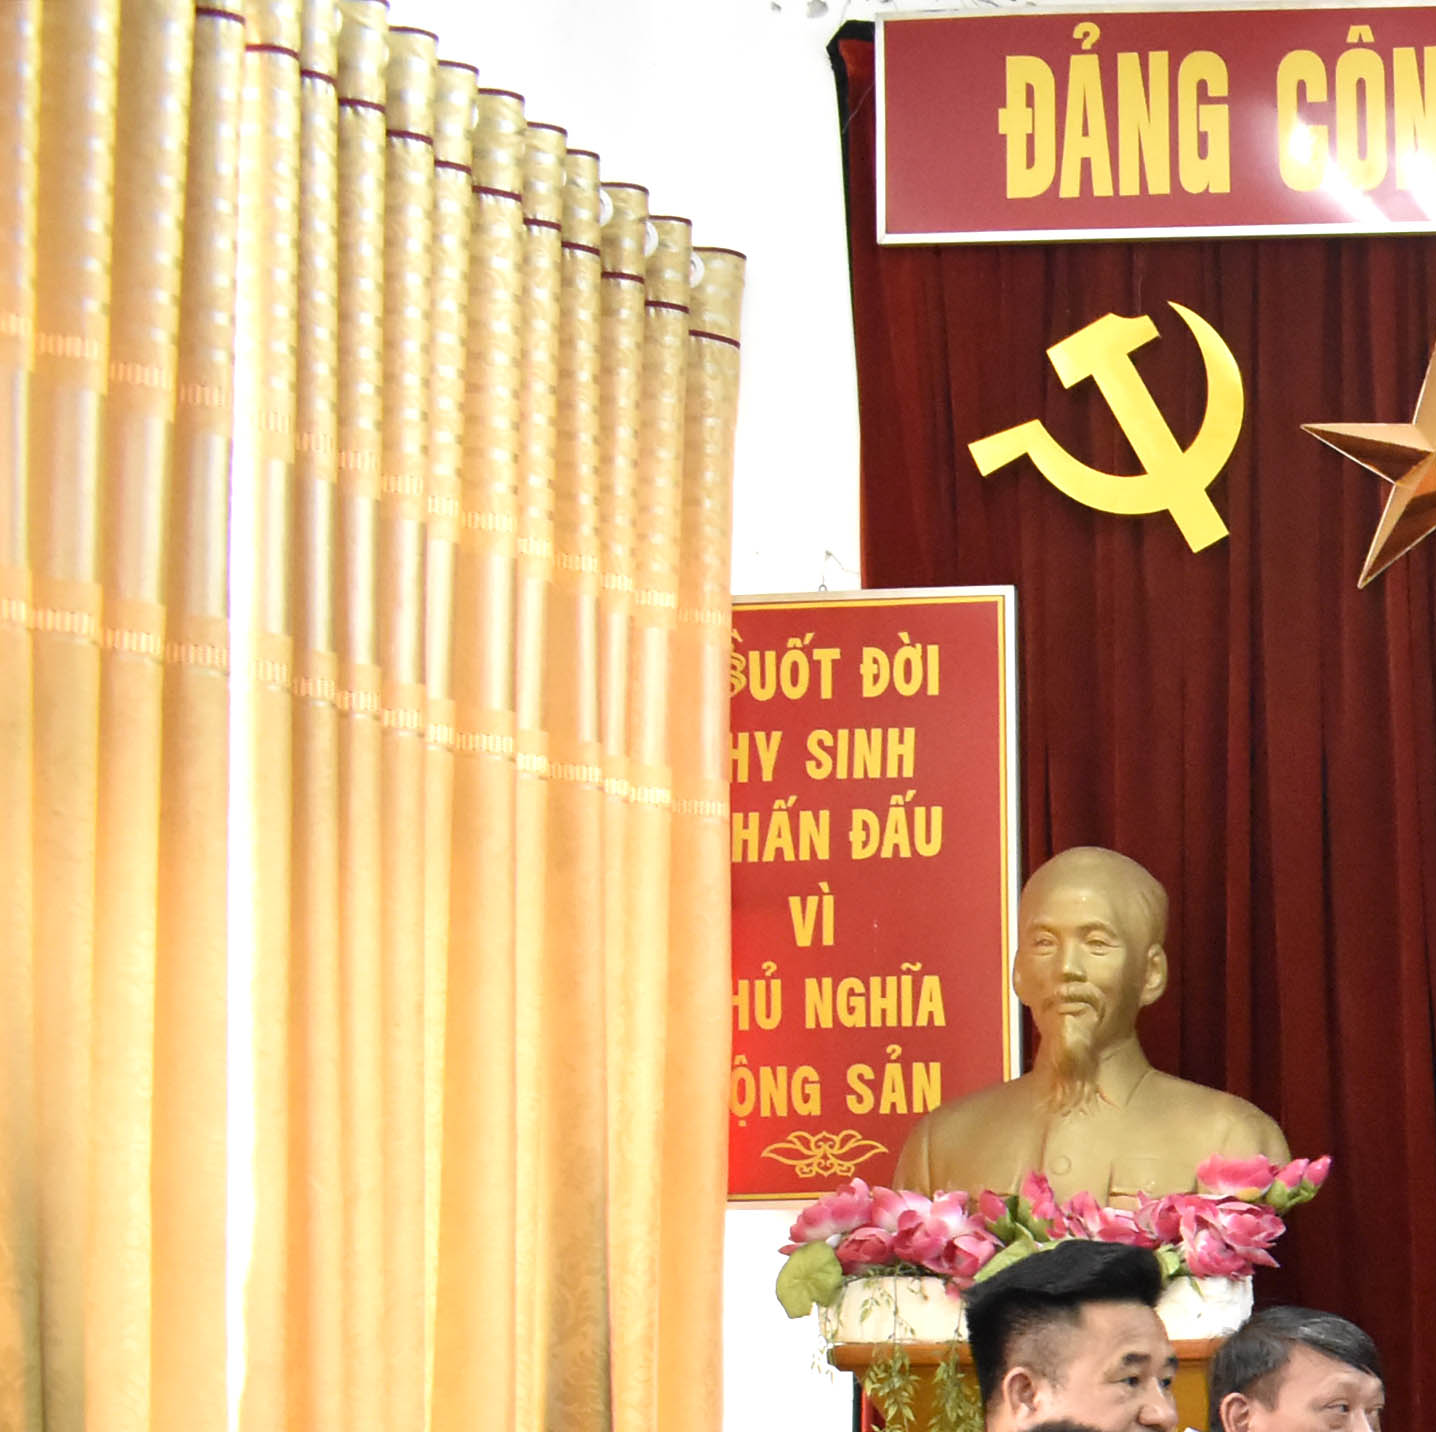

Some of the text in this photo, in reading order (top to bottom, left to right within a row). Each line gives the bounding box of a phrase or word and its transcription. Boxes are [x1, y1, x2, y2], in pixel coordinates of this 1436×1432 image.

[999, 25, 1231, 199] ĐẢNG
[860, 632, 940, 698] ĐỜI
[806, 728, 916, 780] SINH
[731, 789, 943, 863] HẤN ĐẤU
[788, 882, 834, 947] VÌ
[732, 961, 946, 1031] HỦ NGHĨA
[731, 1045, 942, 1127] ỘNG SẢN
